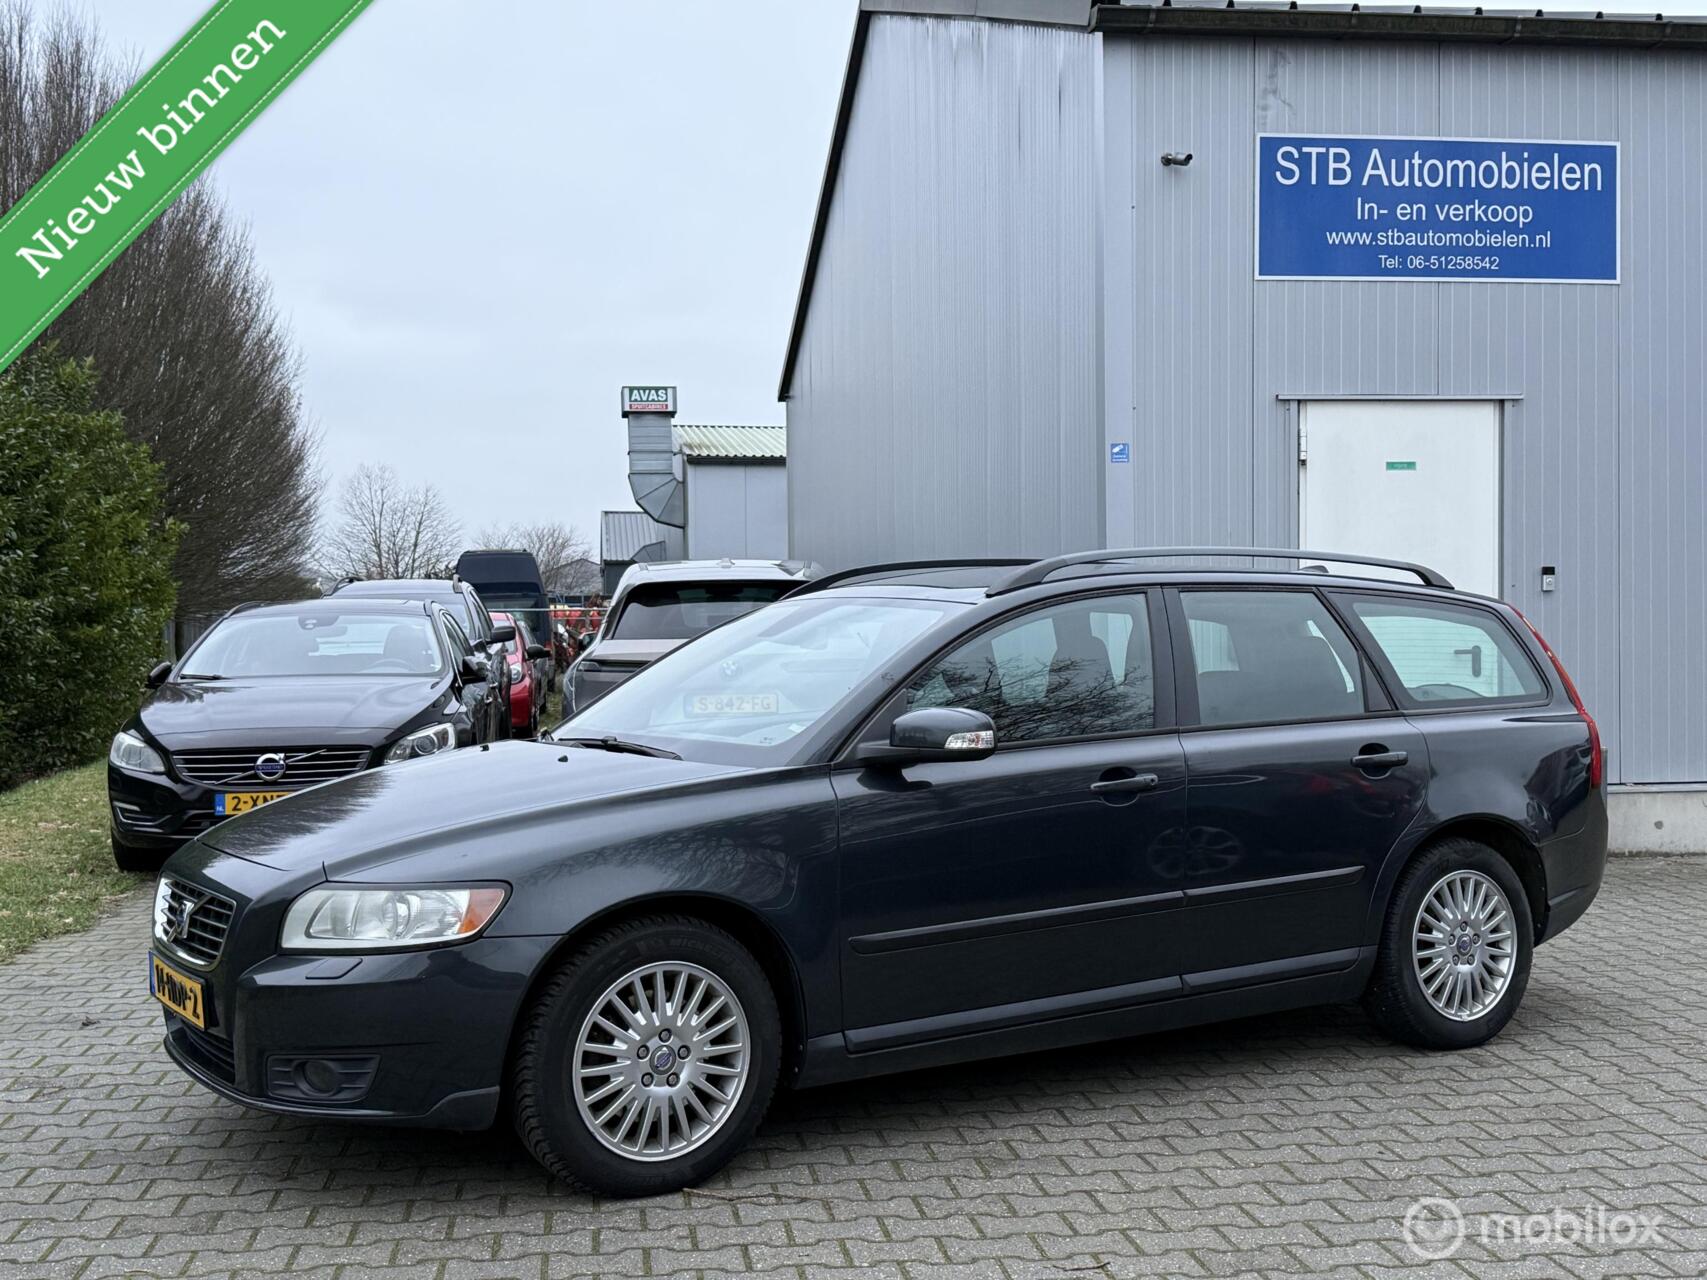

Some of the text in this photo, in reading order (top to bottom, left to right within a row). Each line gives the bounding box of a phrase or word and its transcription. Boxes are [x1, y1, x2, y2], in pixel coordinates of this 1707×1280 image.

[1275, 146, 1602, 191] STB Automobielen
[1356, 197, 1532, 228] In- en verkoop
[1326, 229, 1550, 247] www.stbautomobielen.nl
[1378, 255, 1499, 269] Tel: 06-51258542
[630, 389, 667, 401] AVAS
